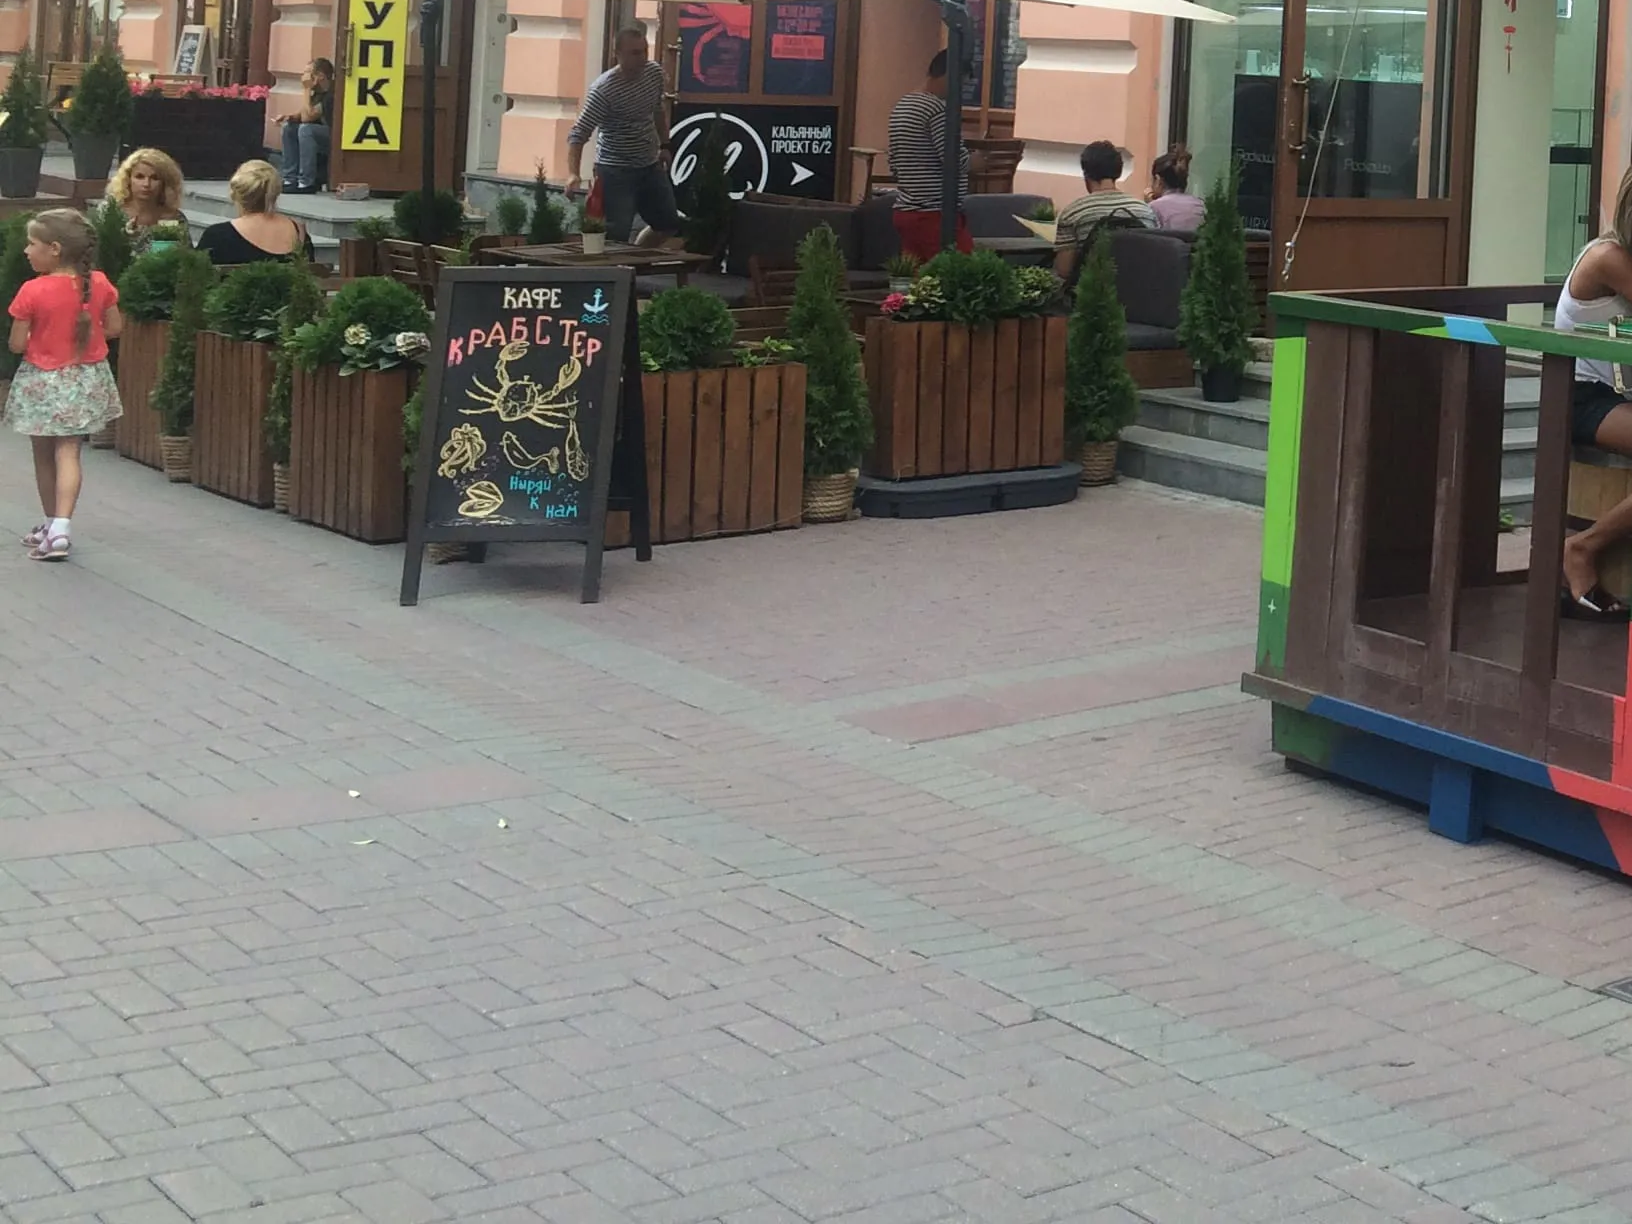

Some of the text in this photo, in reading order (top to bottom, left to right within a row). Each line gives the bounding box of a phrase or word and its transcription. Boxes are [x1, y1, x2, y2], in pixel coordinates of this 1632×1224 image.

[771, 125, 832, 139] КАЛЬЯННЫЙ
[771, 140, 832, 154] ПРОЕКТ 6/2
[503, 287, 561, 309] КАФЕ
[448, 316, 602, 366] КРАБСТЕР
